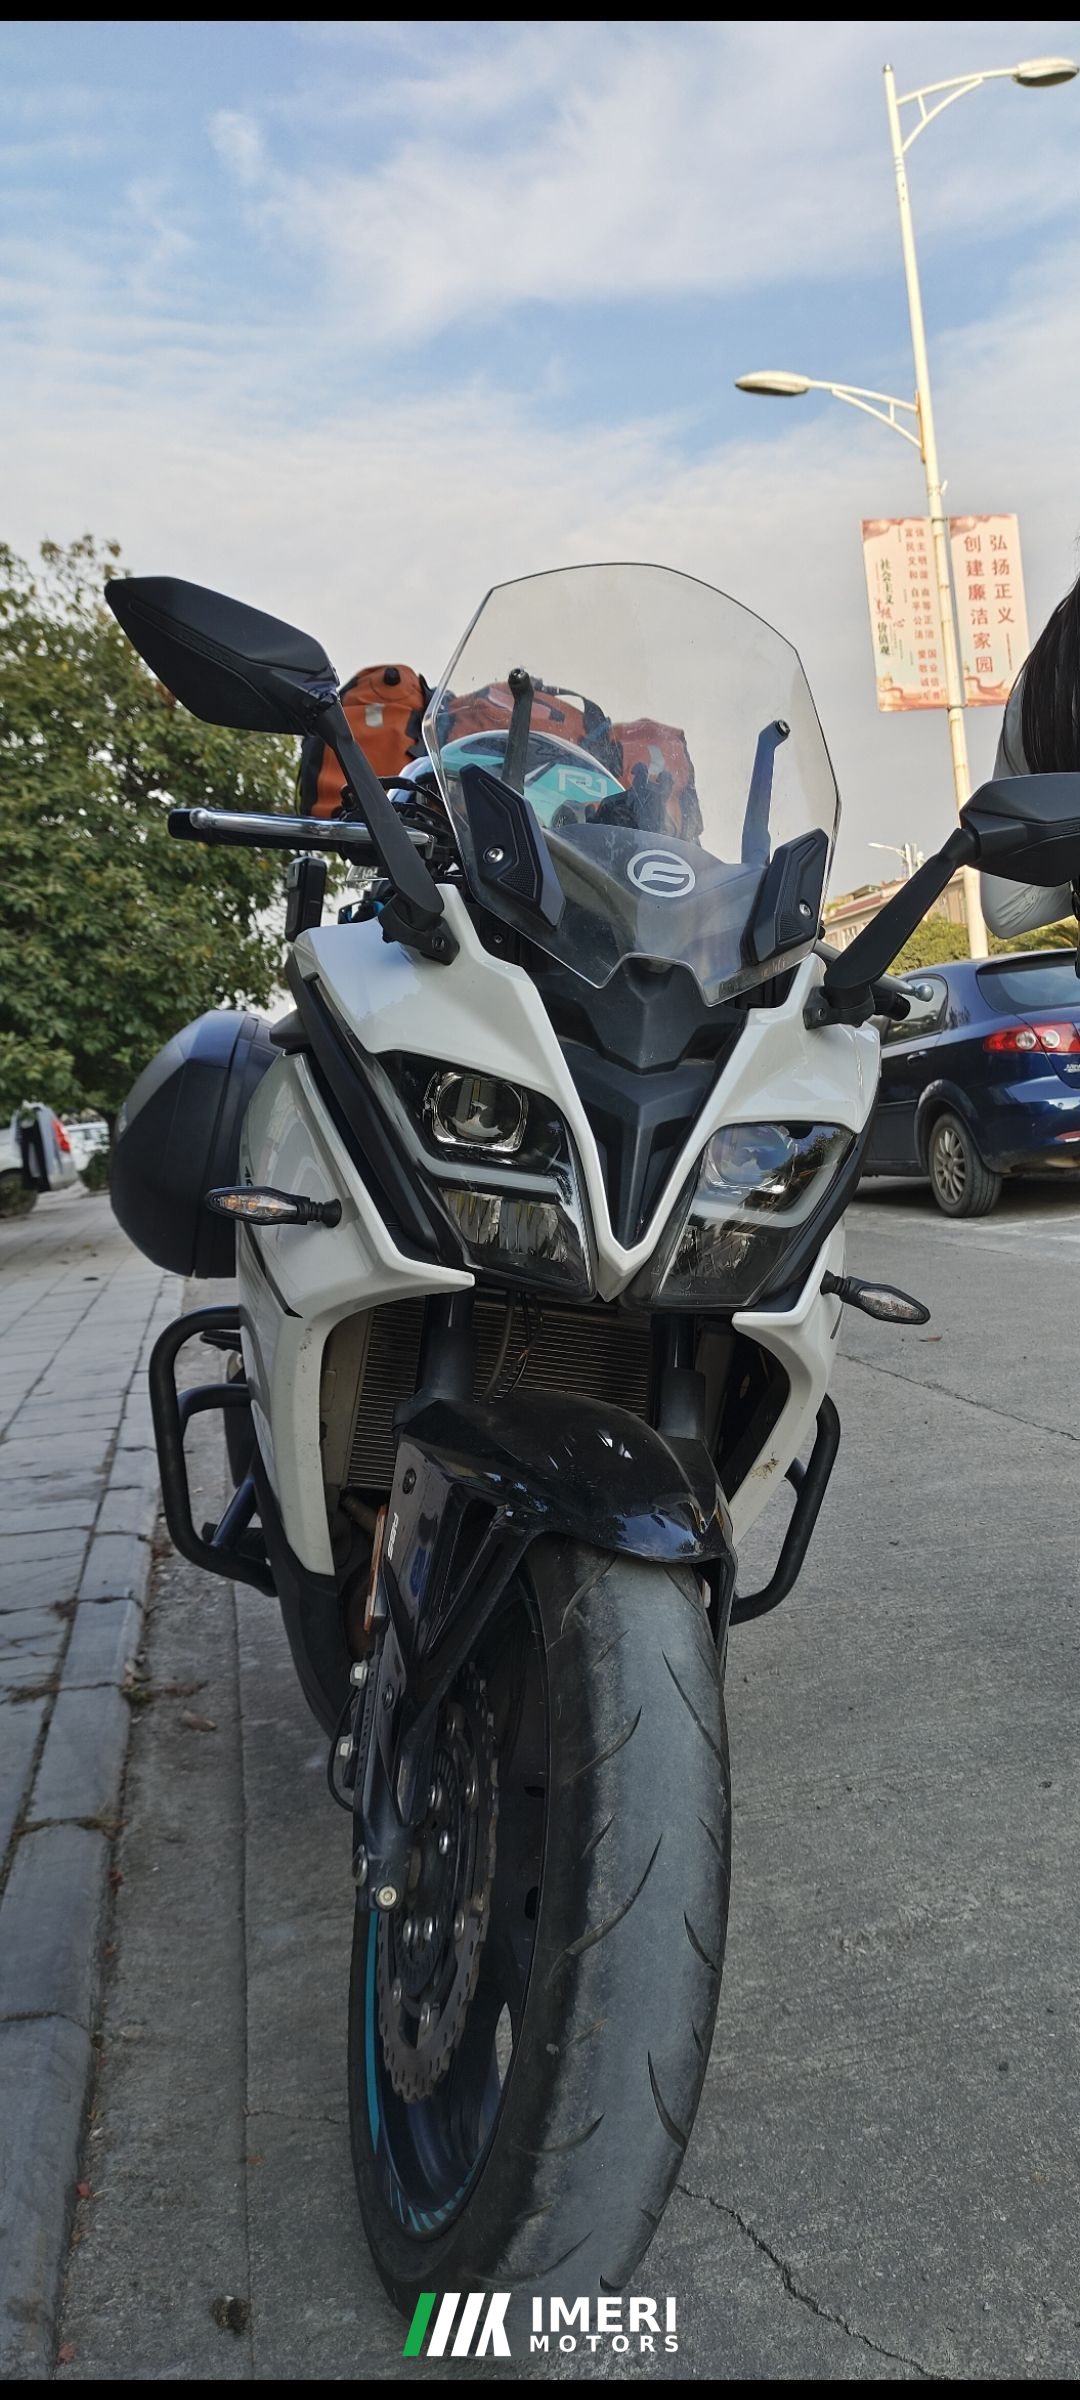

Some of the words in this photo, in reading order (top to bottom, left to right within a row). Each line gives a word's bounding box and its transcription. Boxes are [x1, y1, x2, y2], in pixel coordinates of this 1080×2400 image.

[964, 535, 994, 673] 创建廉洁家园
[989, 534, 1015, 624] 弘扬正义
